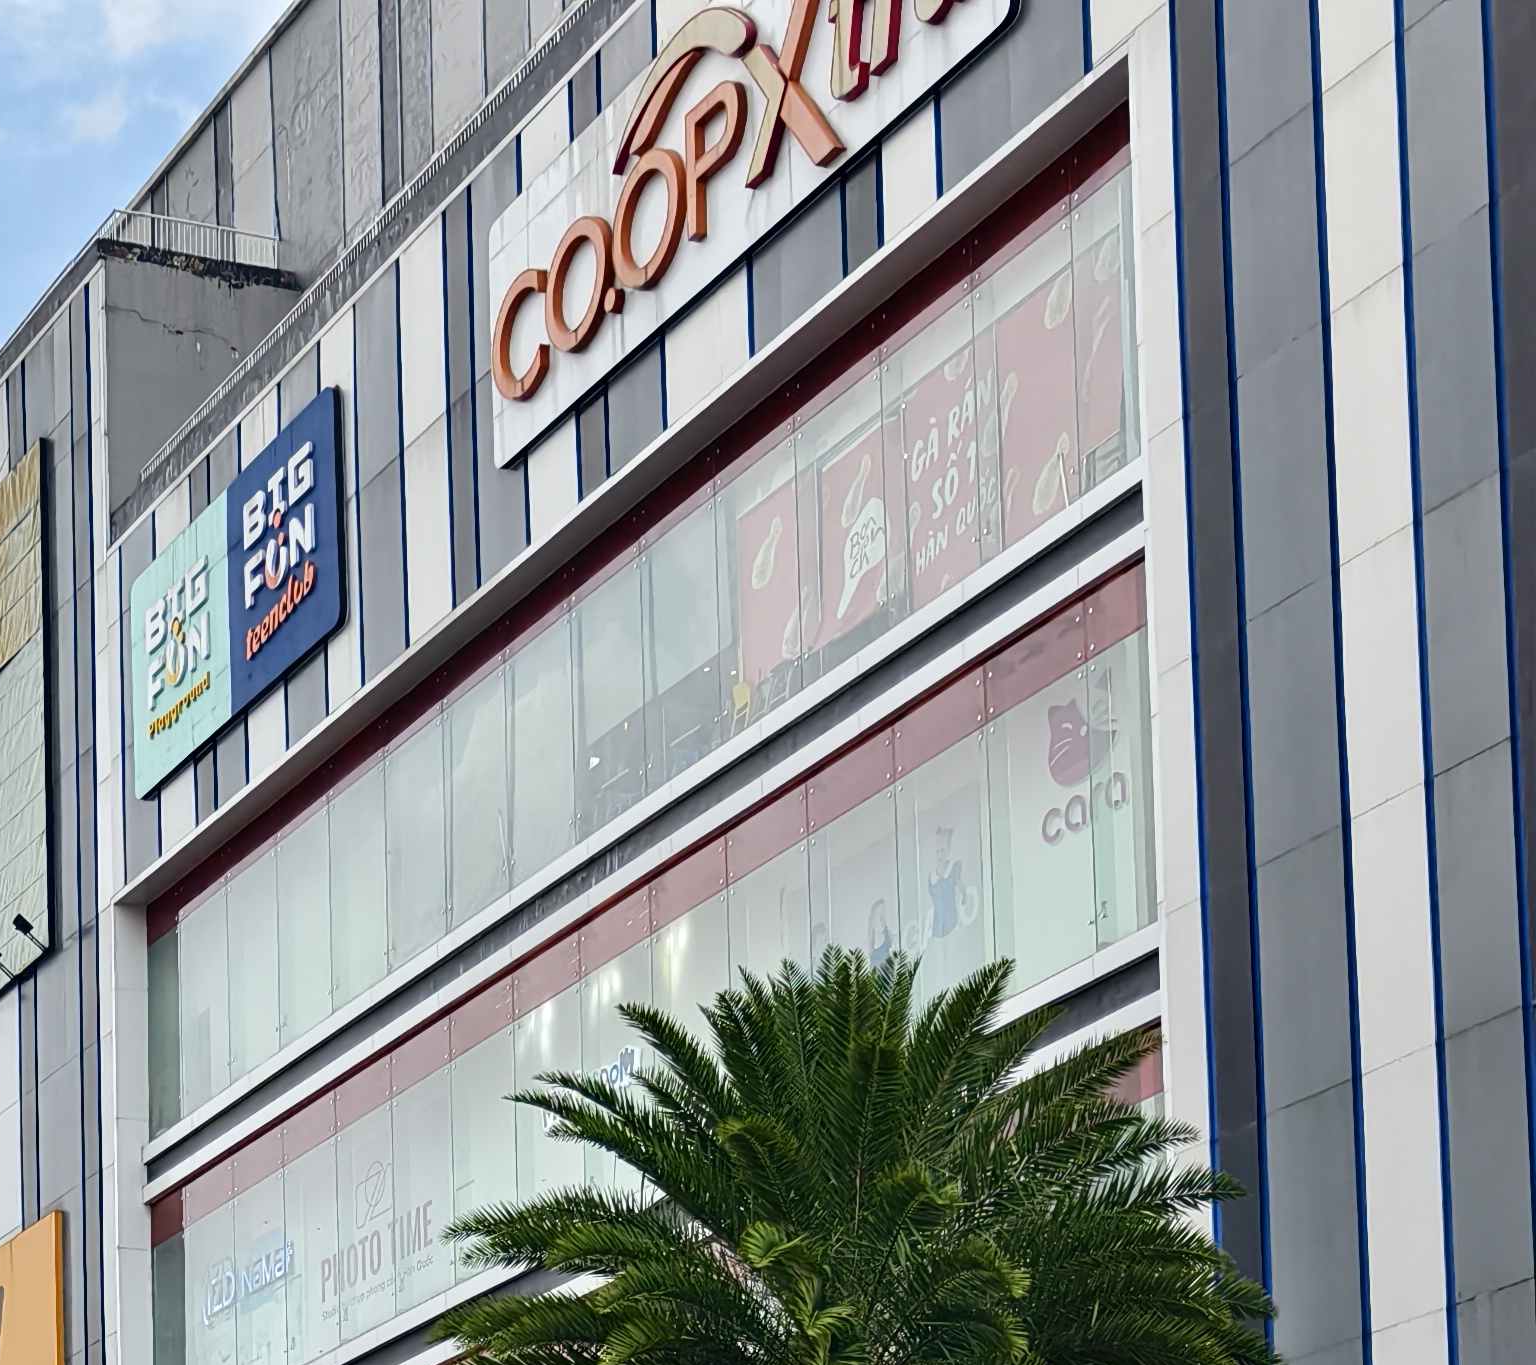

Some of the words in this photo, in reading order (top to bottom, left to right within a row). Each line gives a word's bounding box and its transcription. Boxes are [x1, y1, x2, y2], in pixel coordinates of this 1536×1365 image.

[243, 441, 314, 551] BIG
[911, 417, 939, 482] GÀ
[932, 440, 963, 519] SỐ
[244, 503, 315, 610] FUN
[916, 524, 948, 577] HÀN
[145, 555, 209, 655] BIG
[246, 560, 316, 661] teenclub
[146, 611, 210, 712] FUN
[321, 1230, 382, 1304] PHOTO
[388, 1199, 433, 1266] TIME
